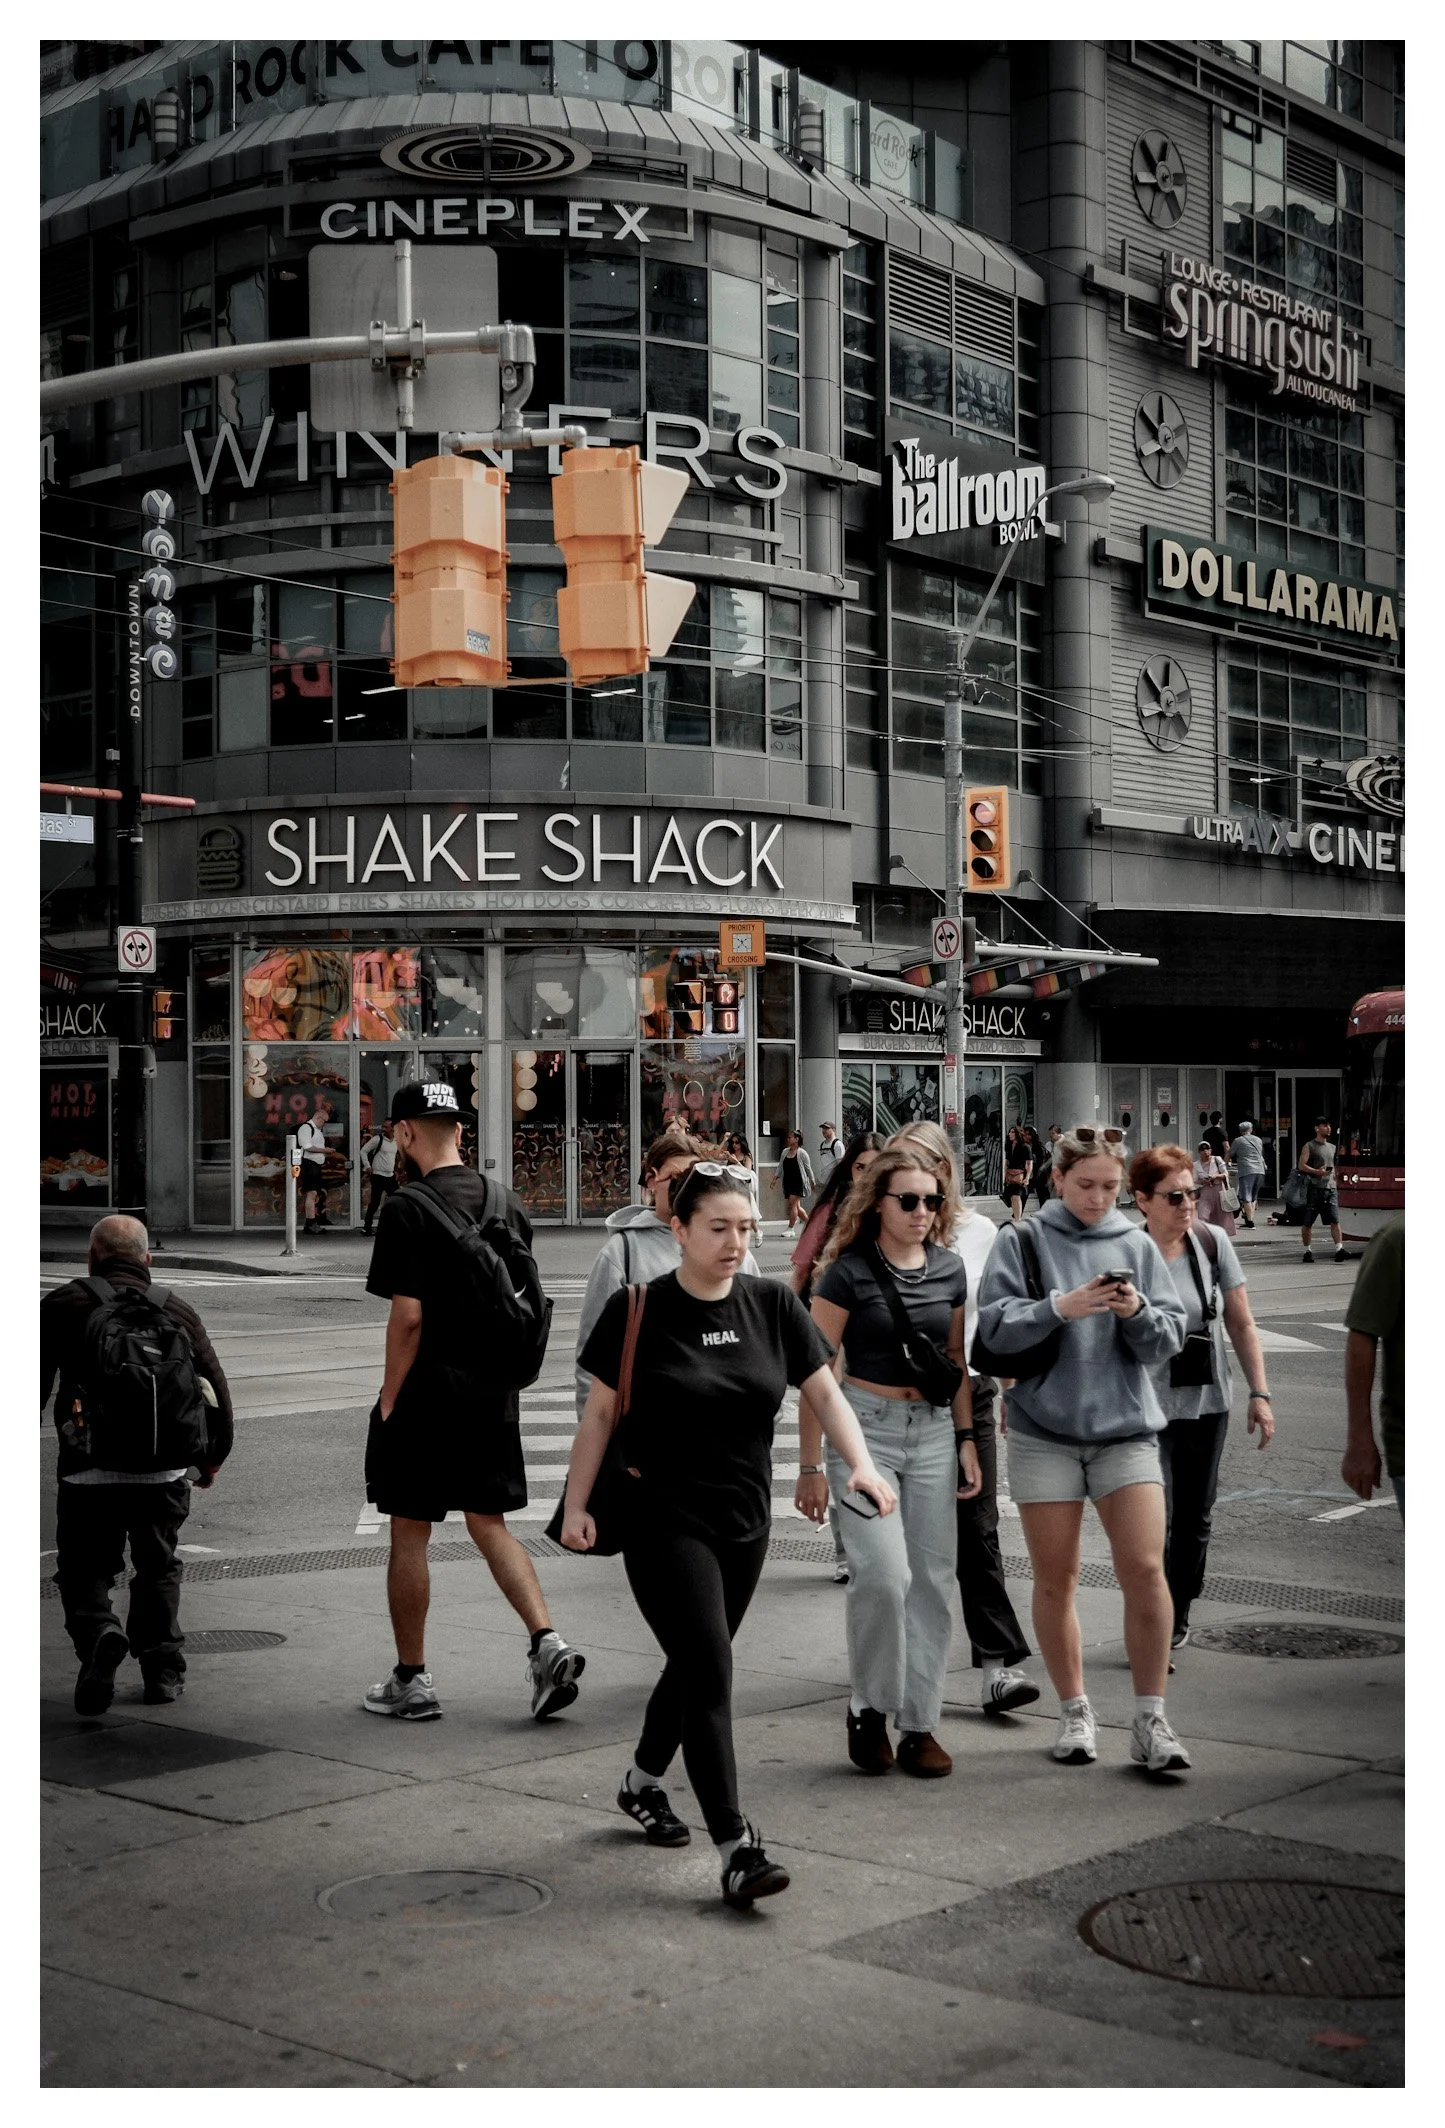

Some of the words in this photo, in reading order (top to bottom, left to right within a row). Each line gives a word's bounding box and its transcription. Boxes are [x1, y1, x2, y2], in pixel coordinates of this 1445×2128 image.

[109, 74, 214, 152] HAD
[320, 197, 650, 243] CINEPLEX
[1171, 251, 1232, 294] LOUNGE
[1241, 279, 1332, 333] RESTAURANT
[1286, 374, 1303, 394] ALL
[1303, 379, 1322, 400] YOU
[1322, 387, 1341, 408] CAN
[900, 438, 935, 481] The
[893, 454, 1048, 540] ballroom
[1000, 519, 1038, 545] BOWL
[1162, 538, 1398, 641] DOLLARAMA
[128, 583, 141, 718] DOWNTOWN
[1193, 816, 1243, 843] ULTRA
[1241, 816, 1294, 857] AVX
[265, 813, 521, 887] SHAKE
[541, 813, 784, 889] SHACK
[253, 897, 329, 914] CUSTARD
[338, 894, 389, 911] FRIES
[399, 892, 476, 910] SHAKES
[486, 892, 526, 908] HOT
[534, 892, 590, 909] DOGS
[600, 892, 712, 912] CONCRETES
[719, 896, 774, 914] FLOATS
[728, 955, 758, 963] CROSSING
[864, 1036, 911, 1050] BURGERS
[50, 1082, 96, 1105] HOT
[427, 1095, 459, 1110] FUEL
[702, 1330, 740, 1346] HEAL
